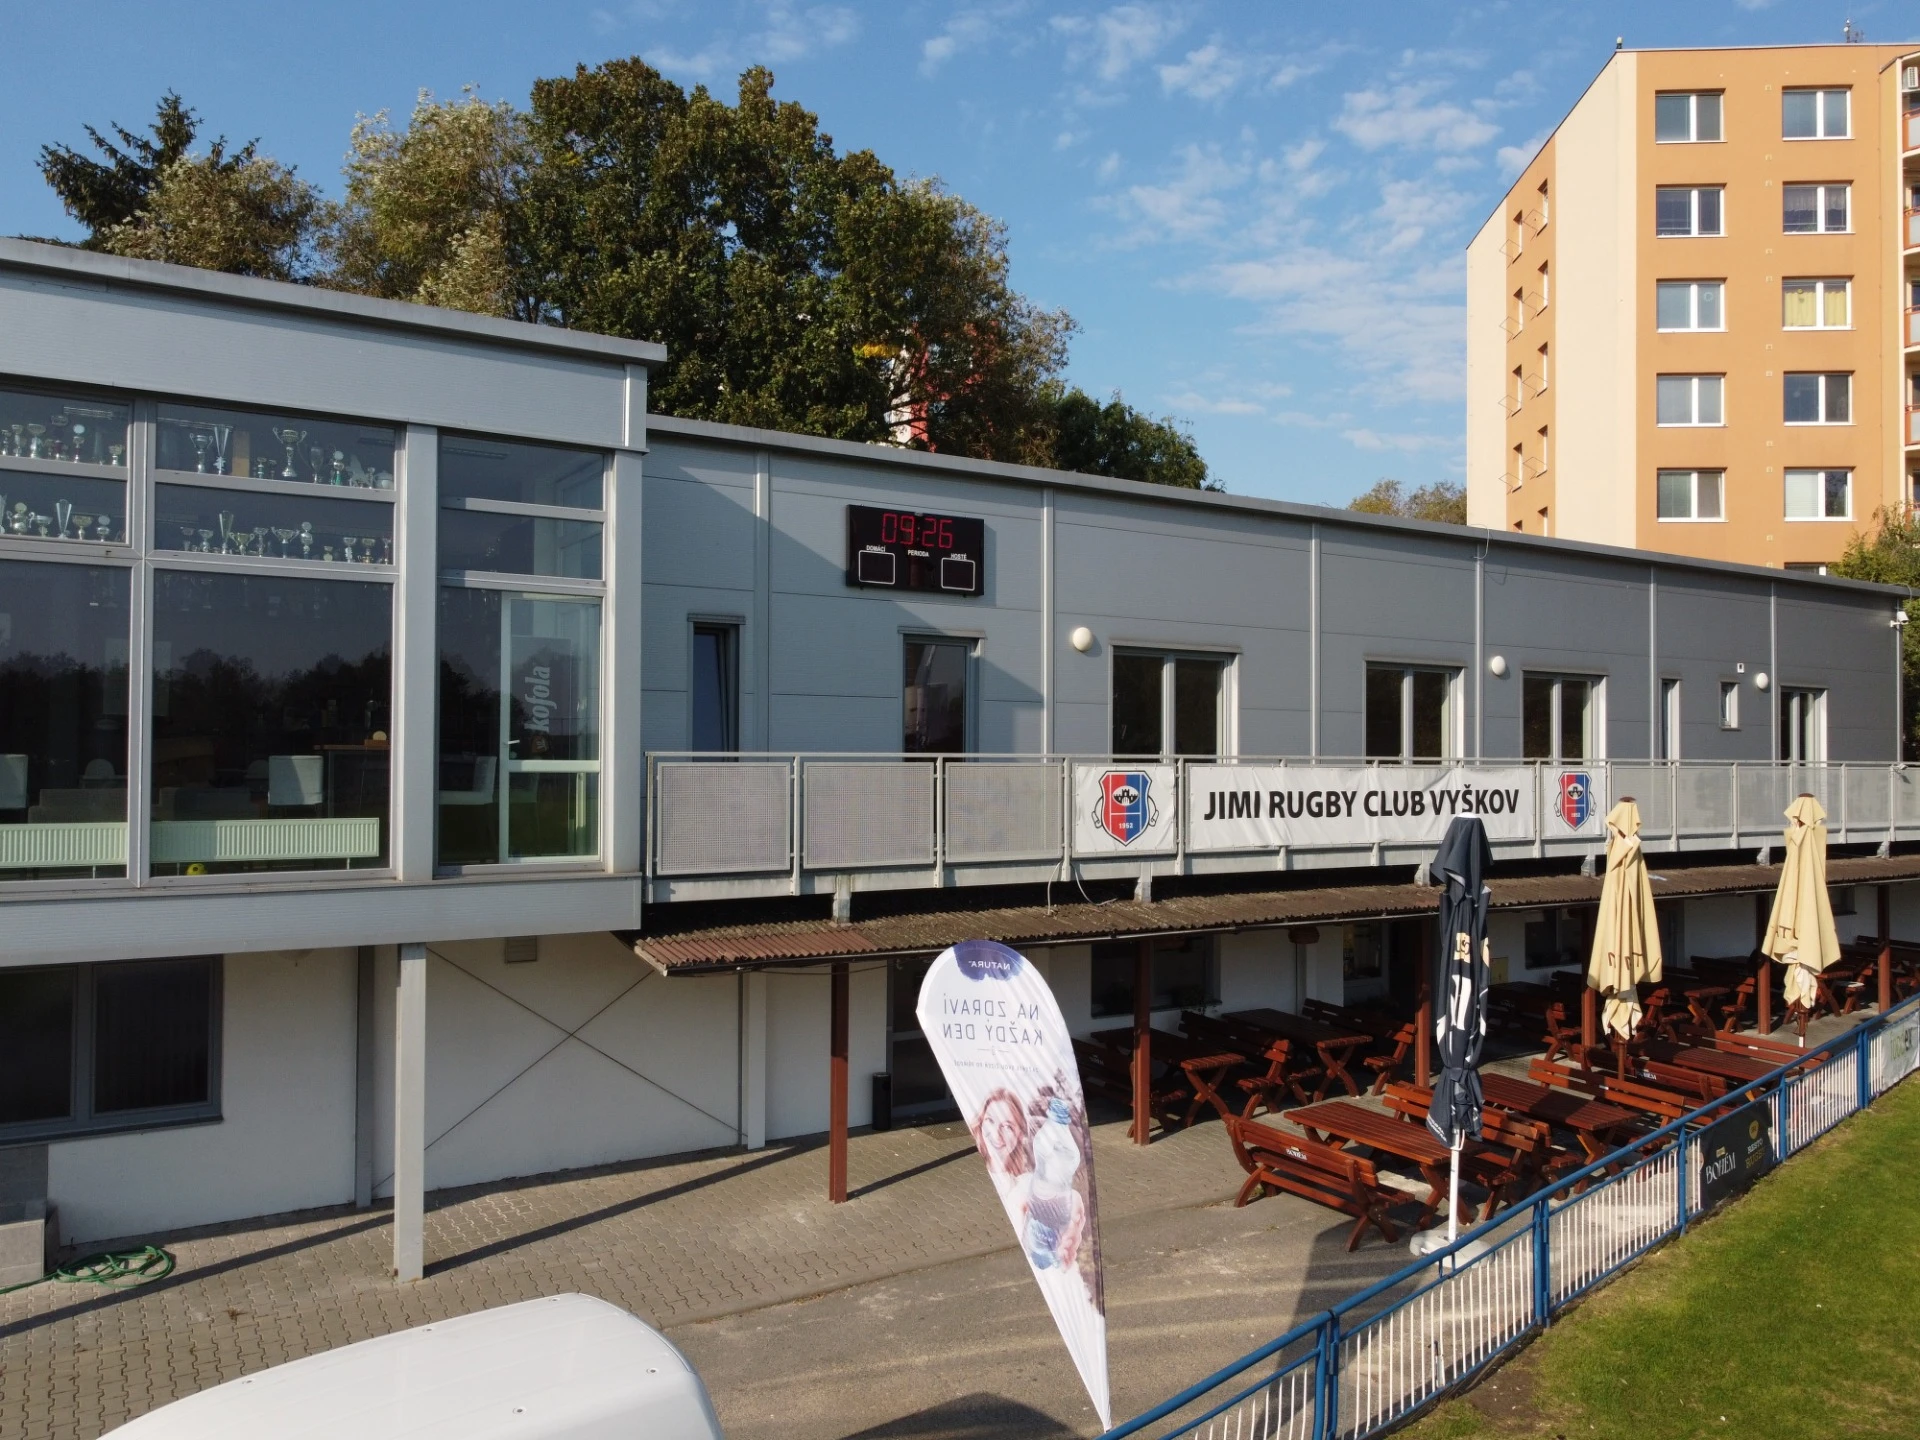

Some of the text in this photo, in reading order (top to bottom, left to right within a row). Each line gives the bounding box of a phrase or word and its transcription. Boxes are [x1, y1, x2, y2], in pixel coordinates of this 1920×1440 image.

[881, 513, 953, 549] 09:26
[907, 549, 929, 557] PERIODA
[950, 552, 968, 560] HOSTÉ
[524, 665, 557, 732] kofola
[1203, 783, 1520, 821] JIMI RUGBY CLUB VYŠKOV
[1705, 1152, 1736, 1185] BOHÉM
